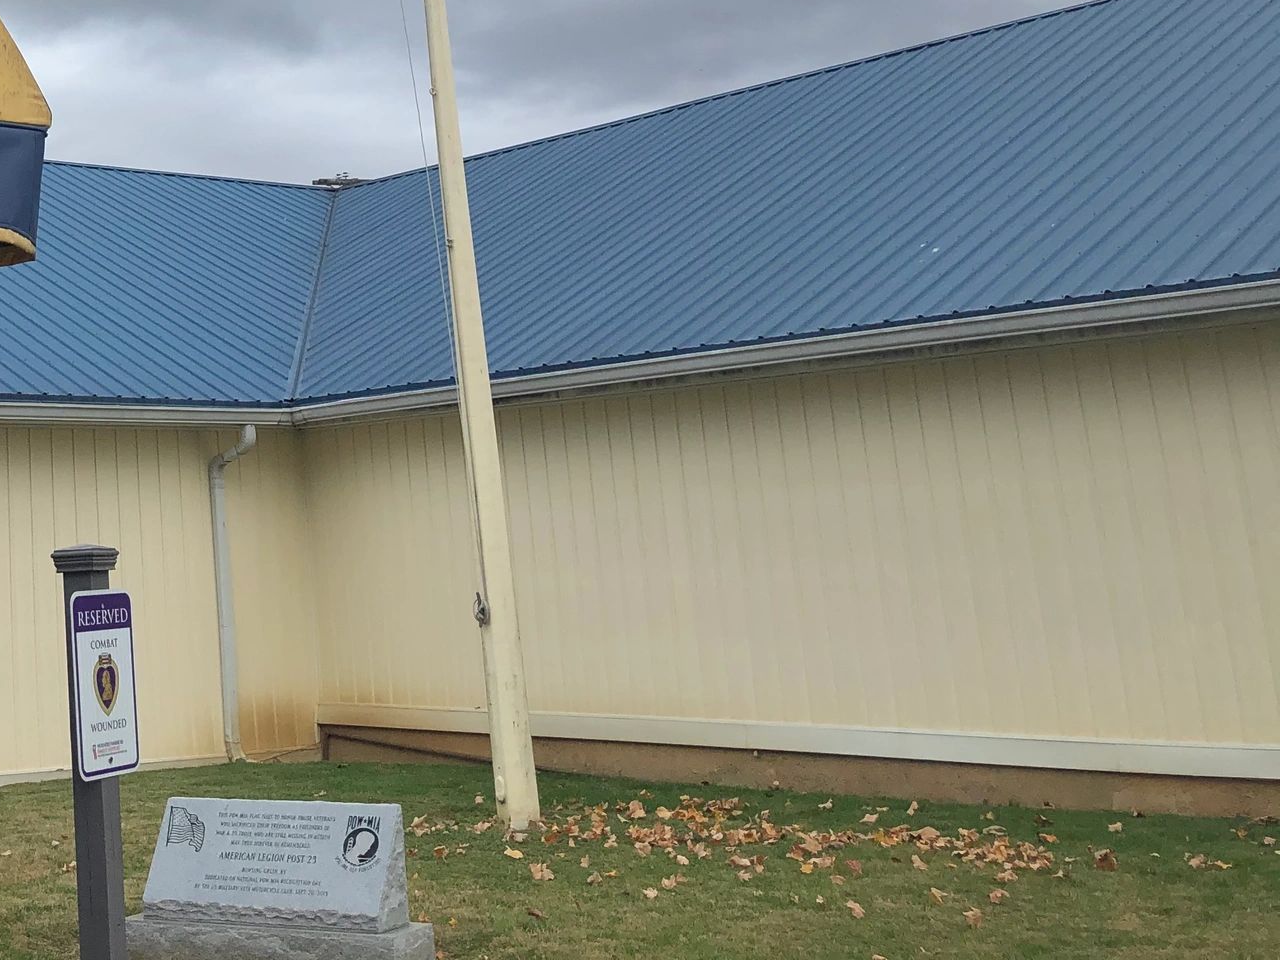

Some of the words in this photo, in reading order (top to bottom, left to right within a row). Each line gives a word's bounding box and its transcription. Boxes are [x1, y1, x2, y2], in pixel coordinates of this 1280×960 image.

[77, 607, 128, 627] RESERVED
[90, 638, 118, 650] COMBAT
[90, 718, 127, 733] WOUNDED
[219, 852, 255, 861] AMERICAN
[258, 853, 284, 862] LEGION
[287, 854, 305, 864] POST
[307, 855, 317, 864] 23
